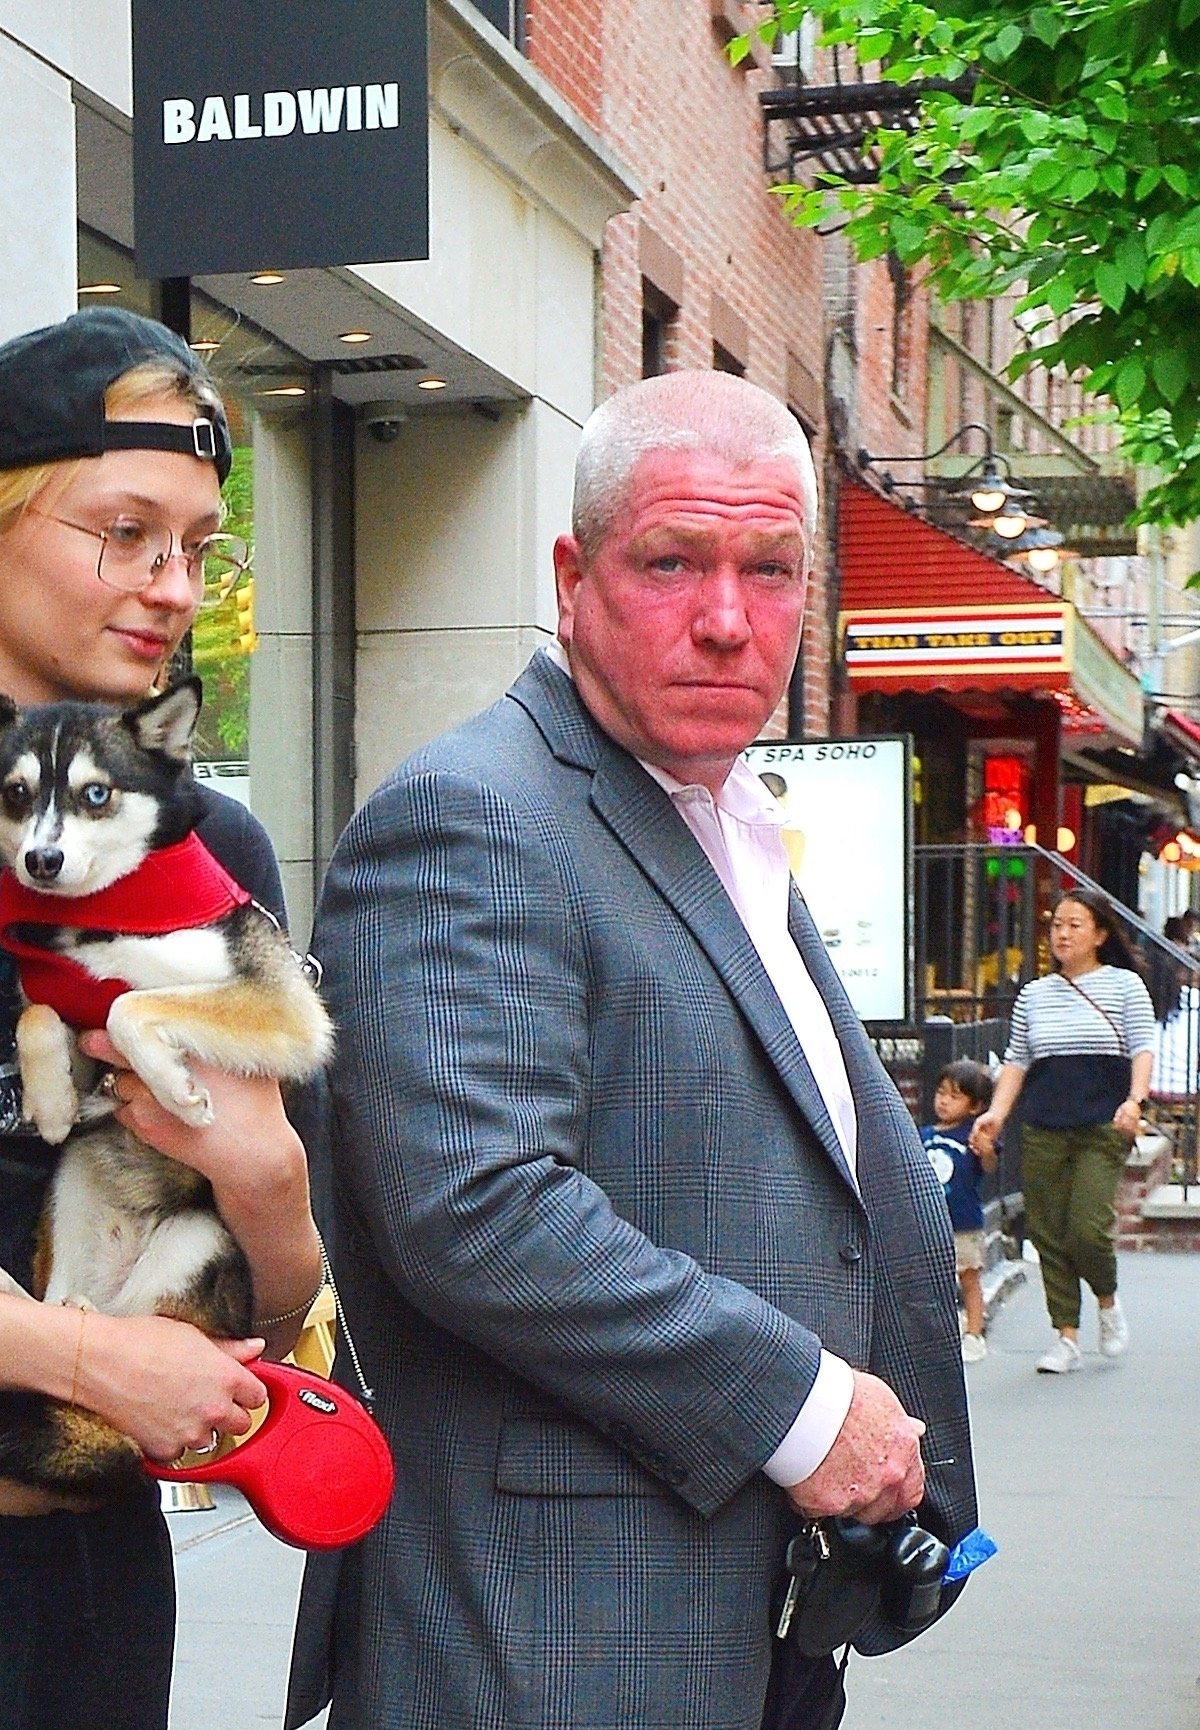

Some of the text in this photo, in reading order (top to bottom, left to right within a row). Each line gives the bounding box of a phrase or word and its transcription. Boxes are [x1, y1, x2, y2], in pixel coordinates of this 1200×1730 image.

[162, 82, 400, 144] BALDWIN
[853, 631, 1056, 649] THAI TAKE OUT
[763, 747, 805, 763] SPA
[814, 744, 877, 761] SOHO
